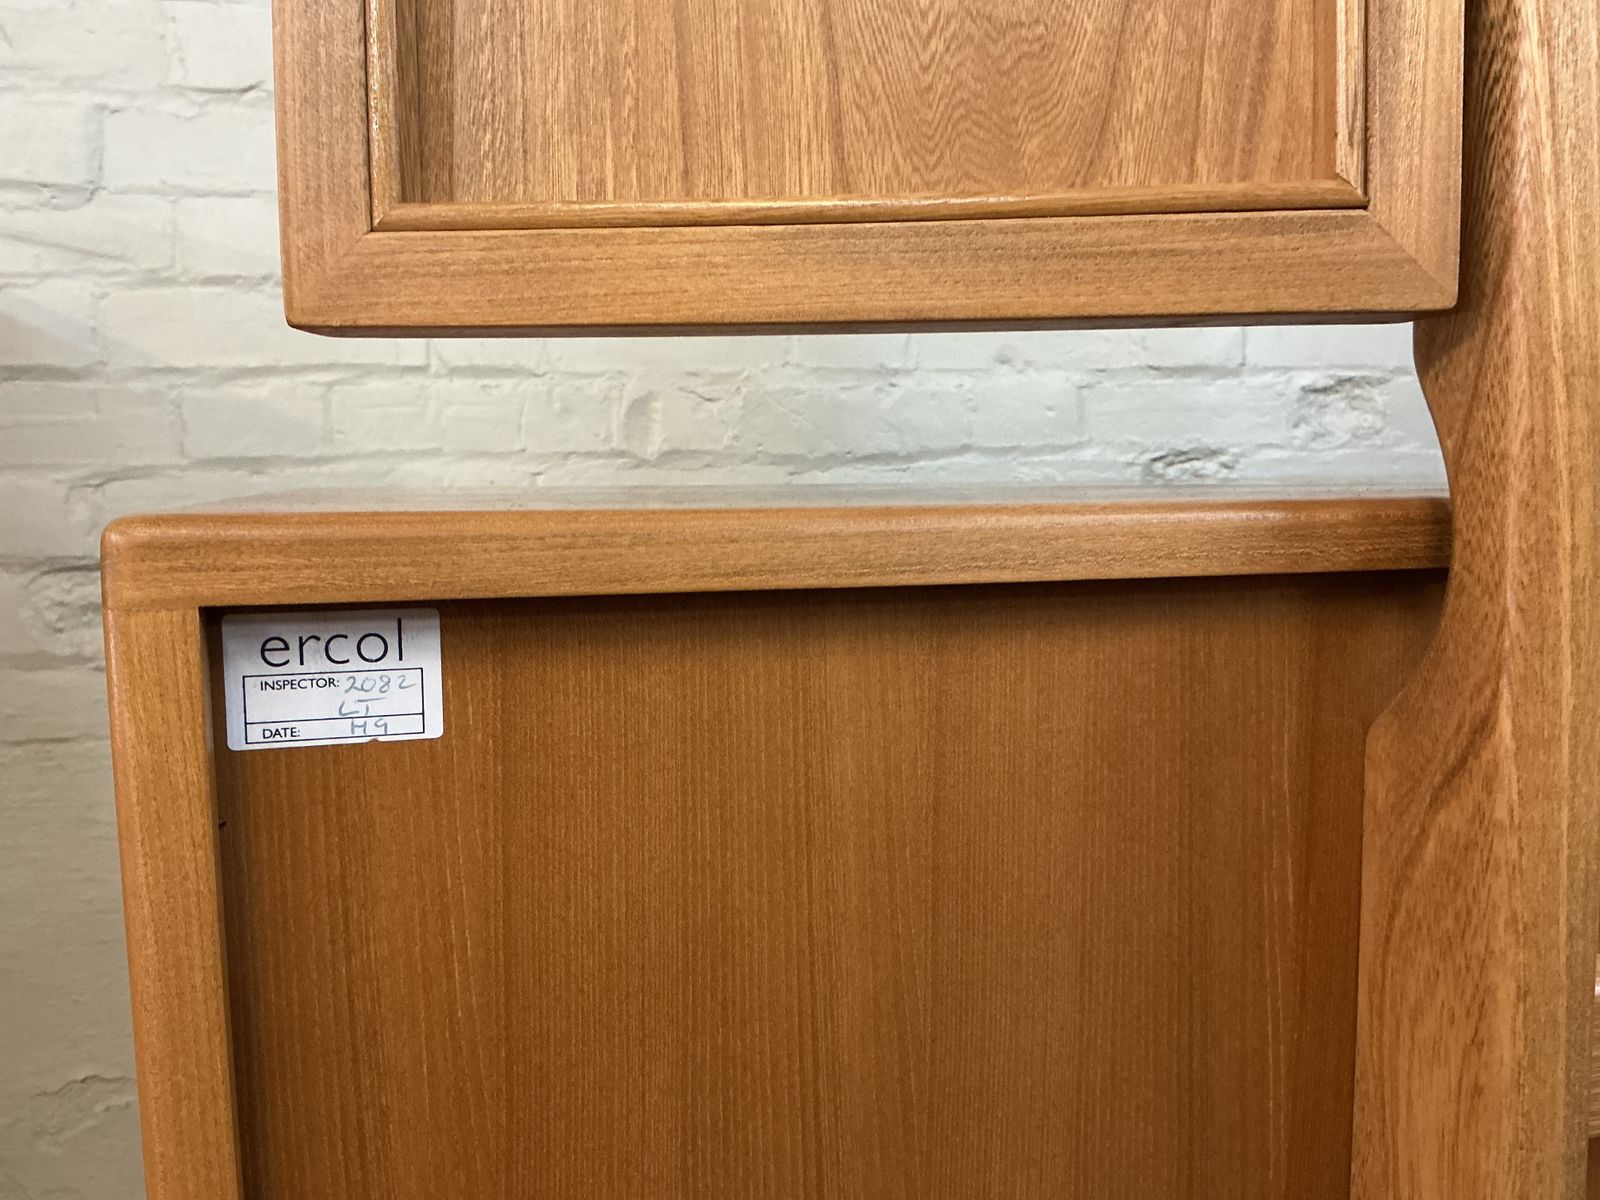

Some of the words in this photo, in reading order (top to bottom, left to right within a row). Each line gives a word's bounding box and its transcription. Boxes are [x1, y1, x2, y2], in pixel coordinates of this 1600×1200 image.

[260, 617, 403, 667] ercol
[260, 677, 340, 691] INSPECTOR:
[262, 727, 300, 740] DATE:
